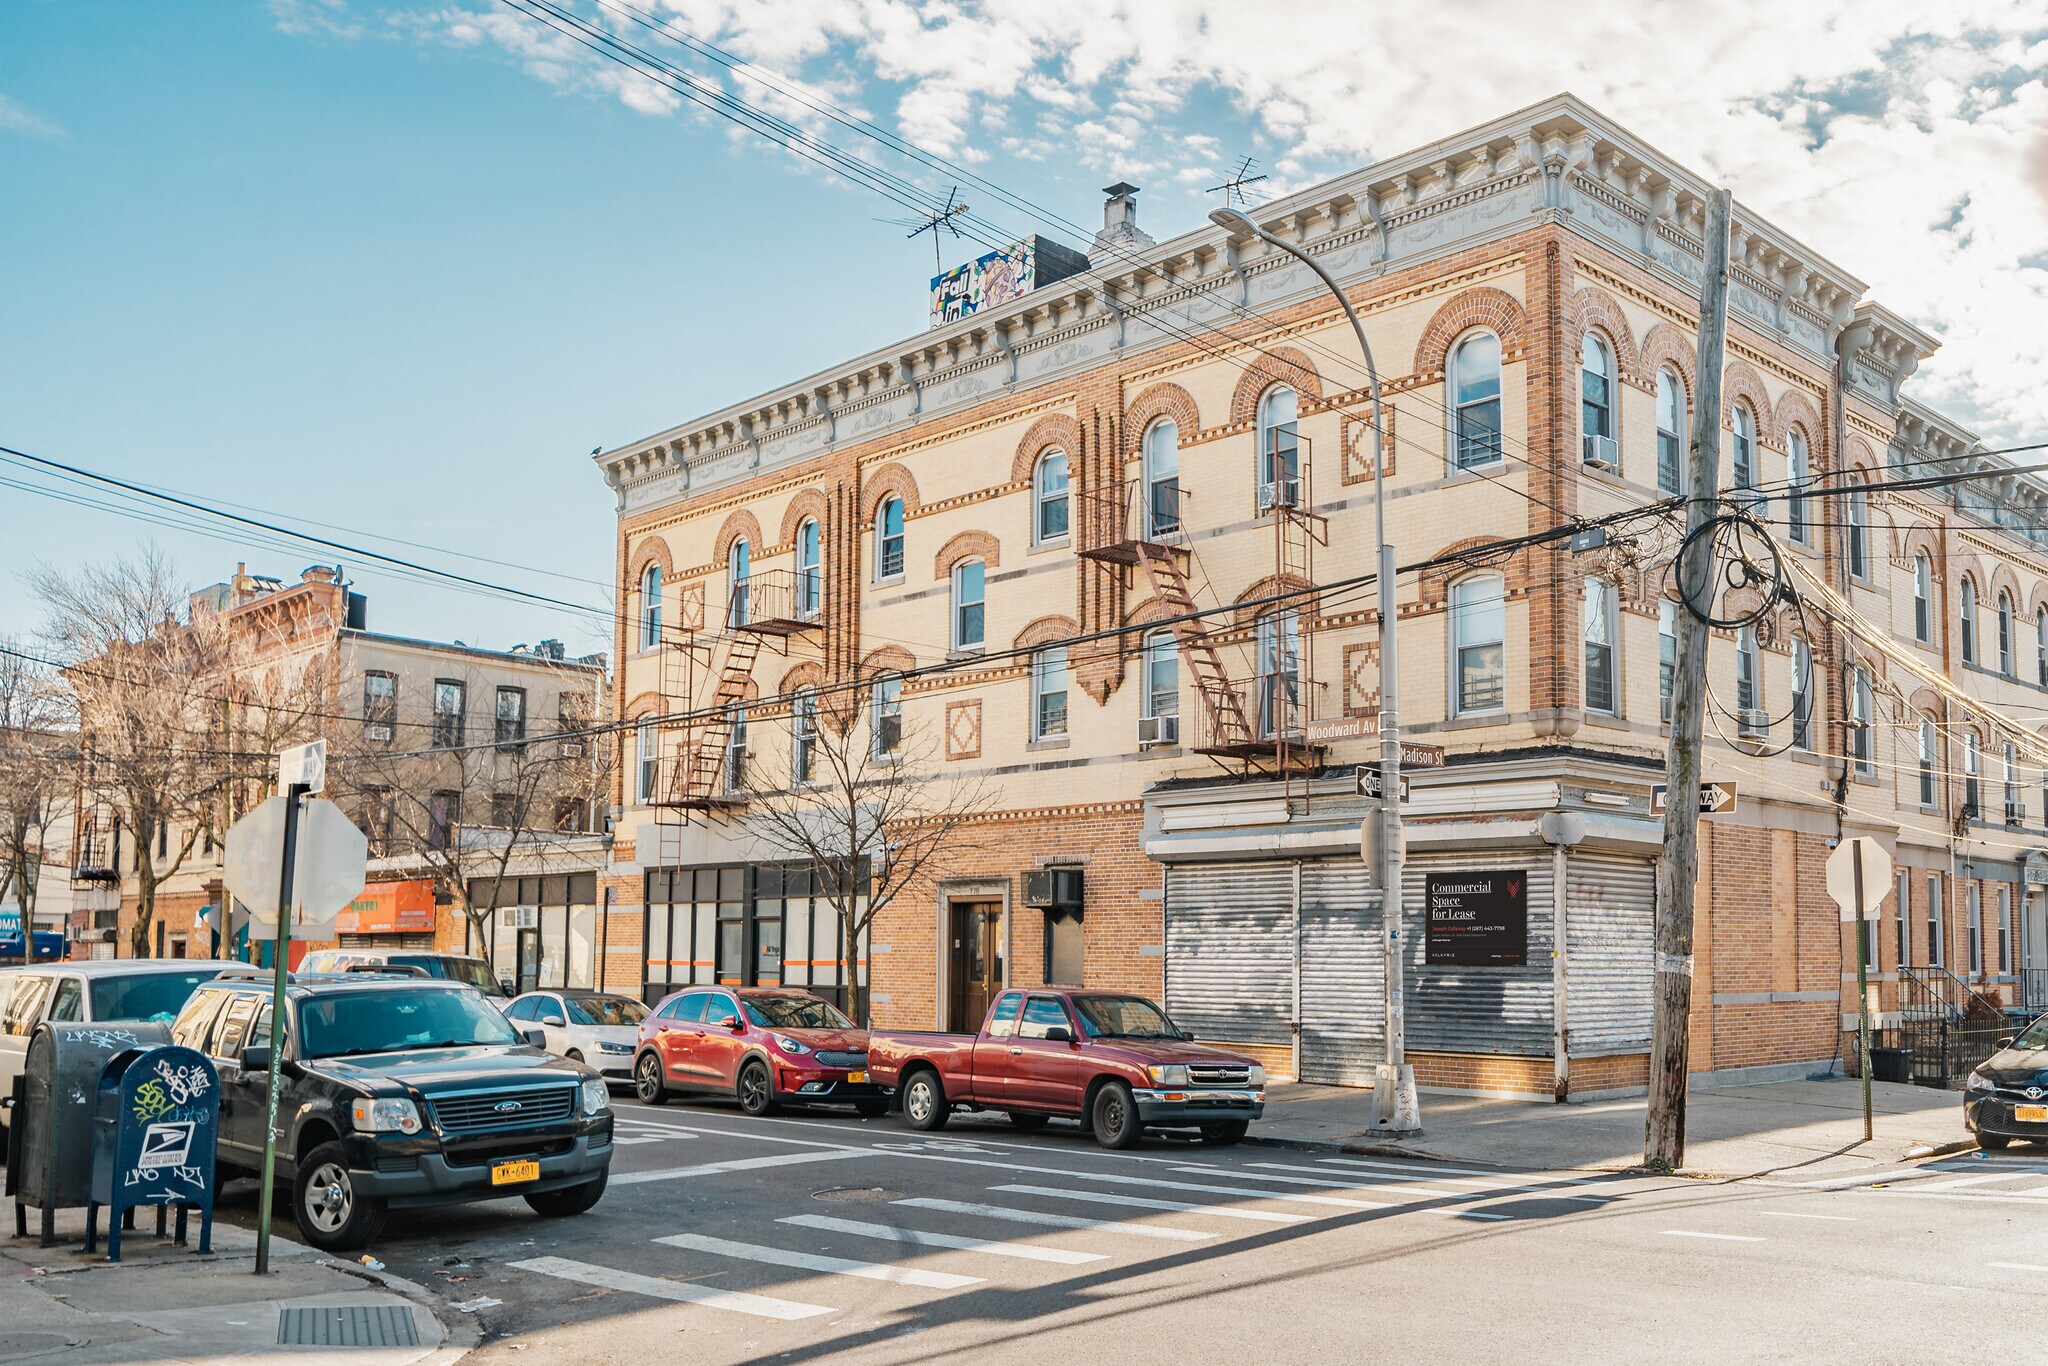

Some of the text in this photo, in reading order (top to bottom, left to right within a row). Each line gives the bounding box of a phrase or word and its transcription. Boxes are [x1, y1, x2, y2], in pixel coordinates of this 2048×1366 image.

[941, 271, 969, 301] Fall
[947, 306, 960, 323] in
[1308, 720, 1375, 740] Woodward Av
[1400, 747, 1444, 765] Madison St
[1365, 777, 1380, 791] ONE
[1700, 791, 1723, 804] WAY
[1432, 880, 1491, 893] Commercial
[1432, 896, 1461, 908] Space
[1432, 908, 1476, 919] for Lease
